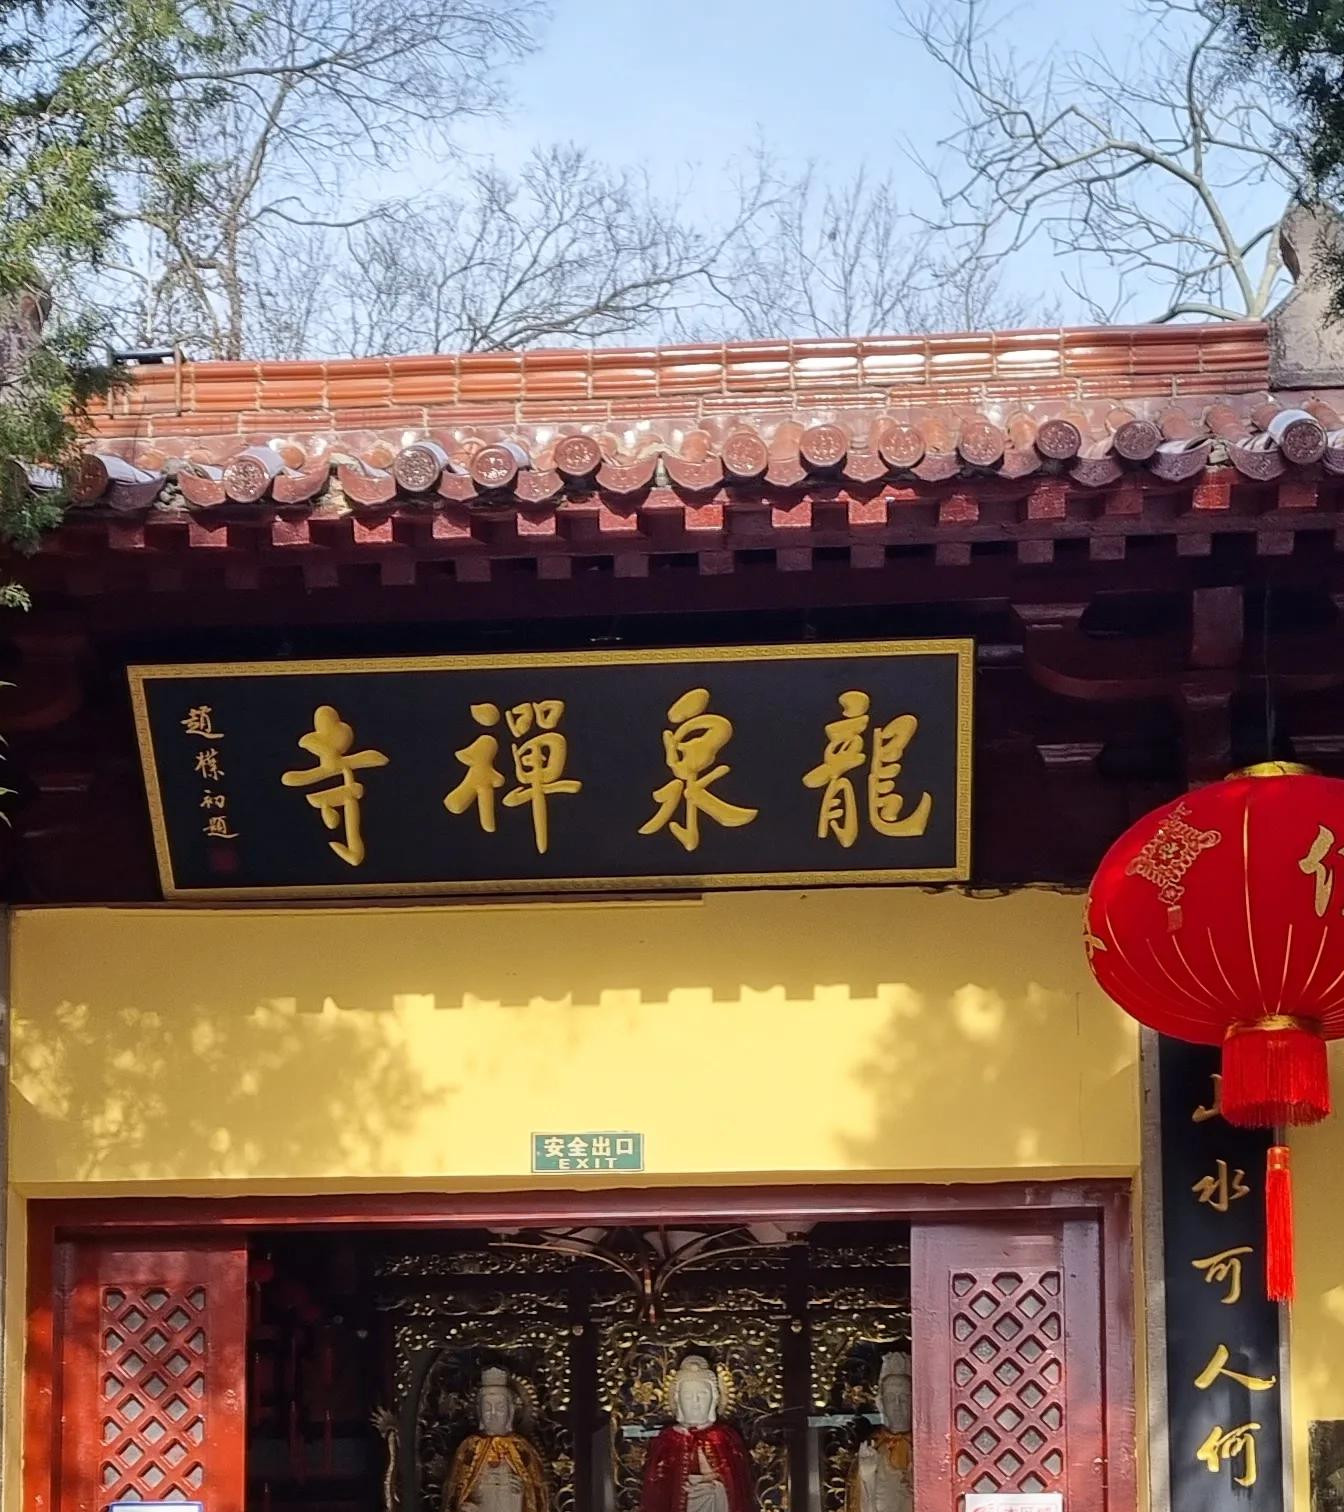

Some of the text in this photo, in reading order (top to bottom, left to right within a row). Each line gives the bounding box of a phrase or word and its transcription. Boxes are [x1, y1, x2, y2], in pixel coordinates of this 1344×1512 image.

[280, 687, 933, 867] 龍泉禪寺
[544, 1136, 633, 1157] 安全出口
[558, 1158, 618, 1170] EXIT
